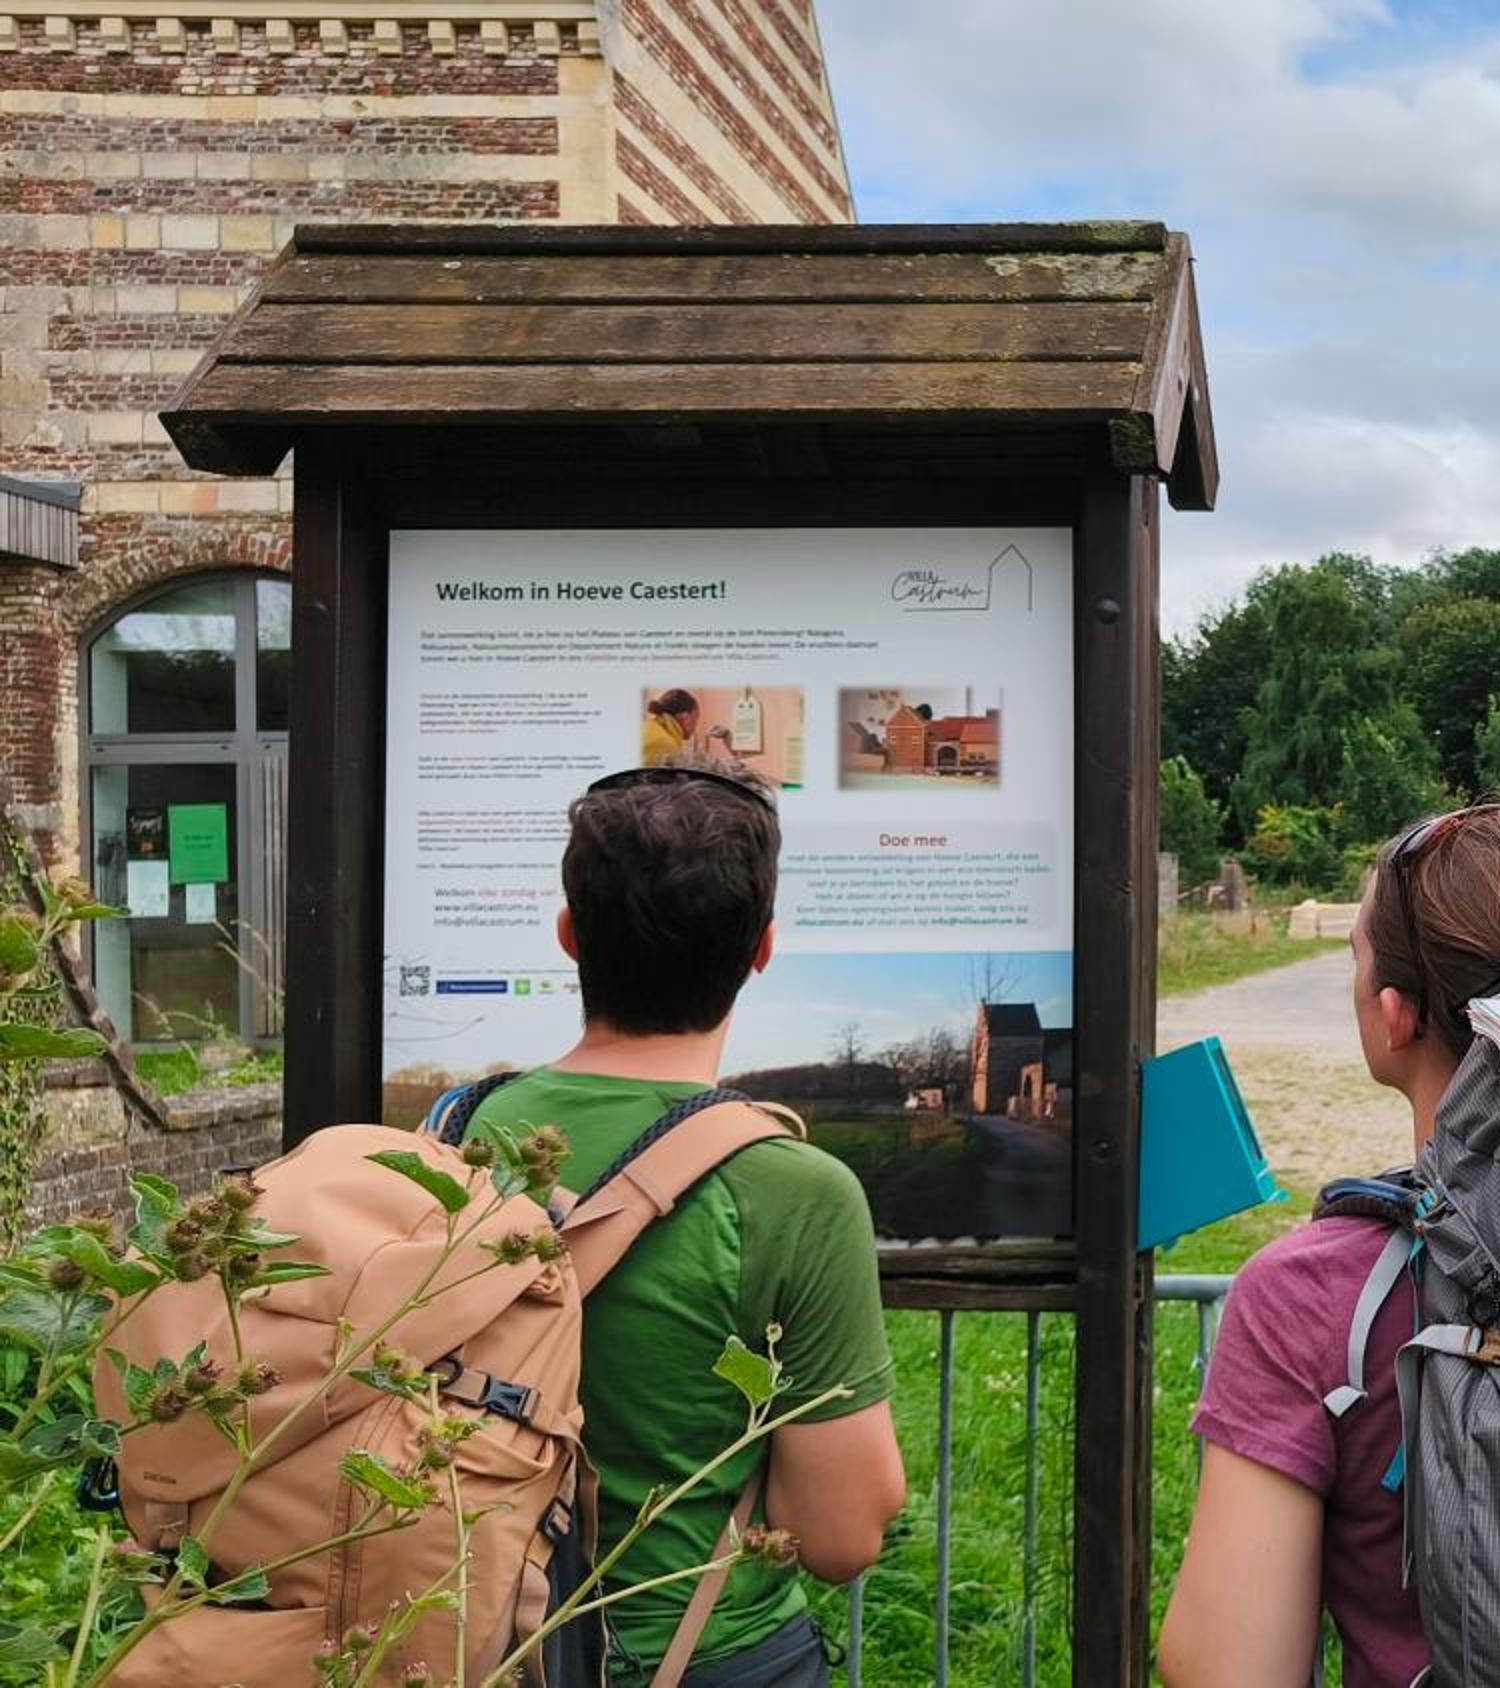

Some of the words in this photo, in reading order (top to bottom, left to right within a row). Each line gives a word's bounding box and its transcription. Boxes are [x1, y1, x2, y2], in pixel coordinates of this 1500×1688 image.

[436, 582, 524, 601] Welkom
[530, 581, 550, 601] in
[556, 583, 623, 600] Hoeve
[629, 581, 726, 600] Caestert!
[879, 833, 909, 847] Doe
[914, 835, 948, 847] mee
